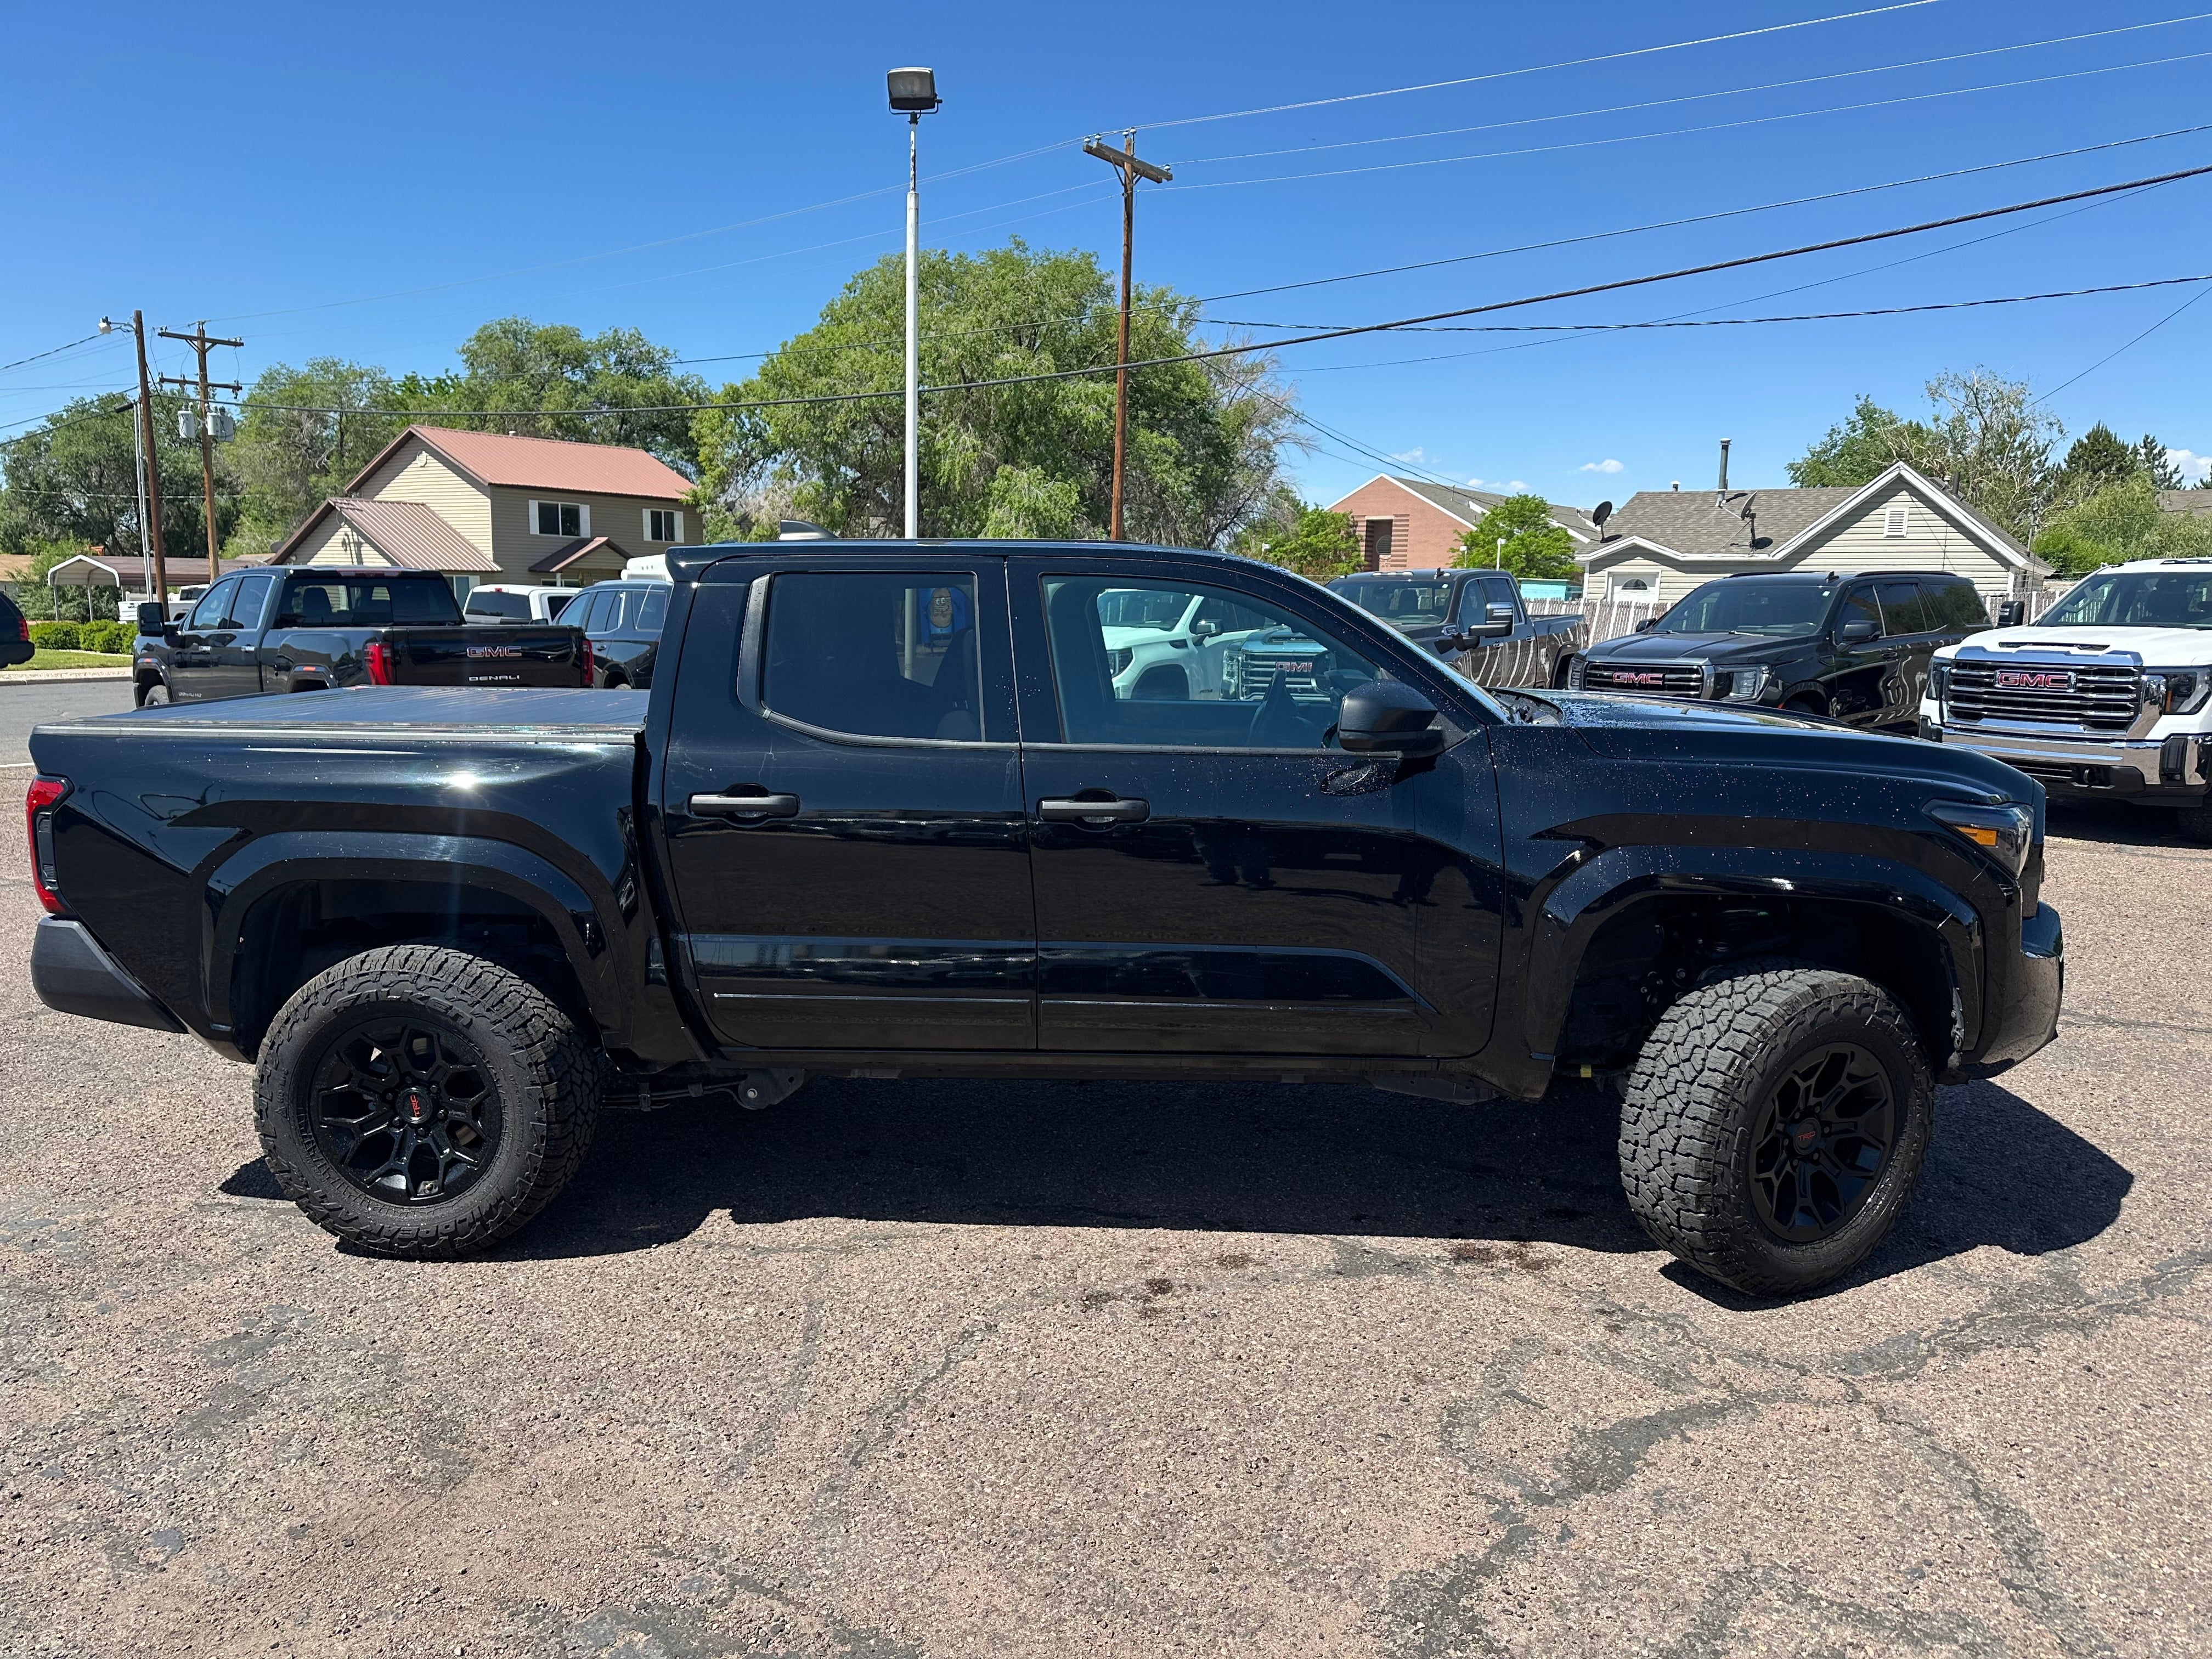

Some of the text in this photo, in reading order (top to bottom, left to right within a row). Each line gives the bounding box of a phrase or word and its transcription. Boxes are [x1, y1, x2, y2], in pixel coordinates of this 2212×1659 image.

[467, 646, 522, 657] GMC
[1613, 673, 1663, 685] GMC
[1999, 673, 2069, 688] GMC
[410, 1094, 421, 1118] TRD
[1797, 1131, 1816, 1141] TRD
